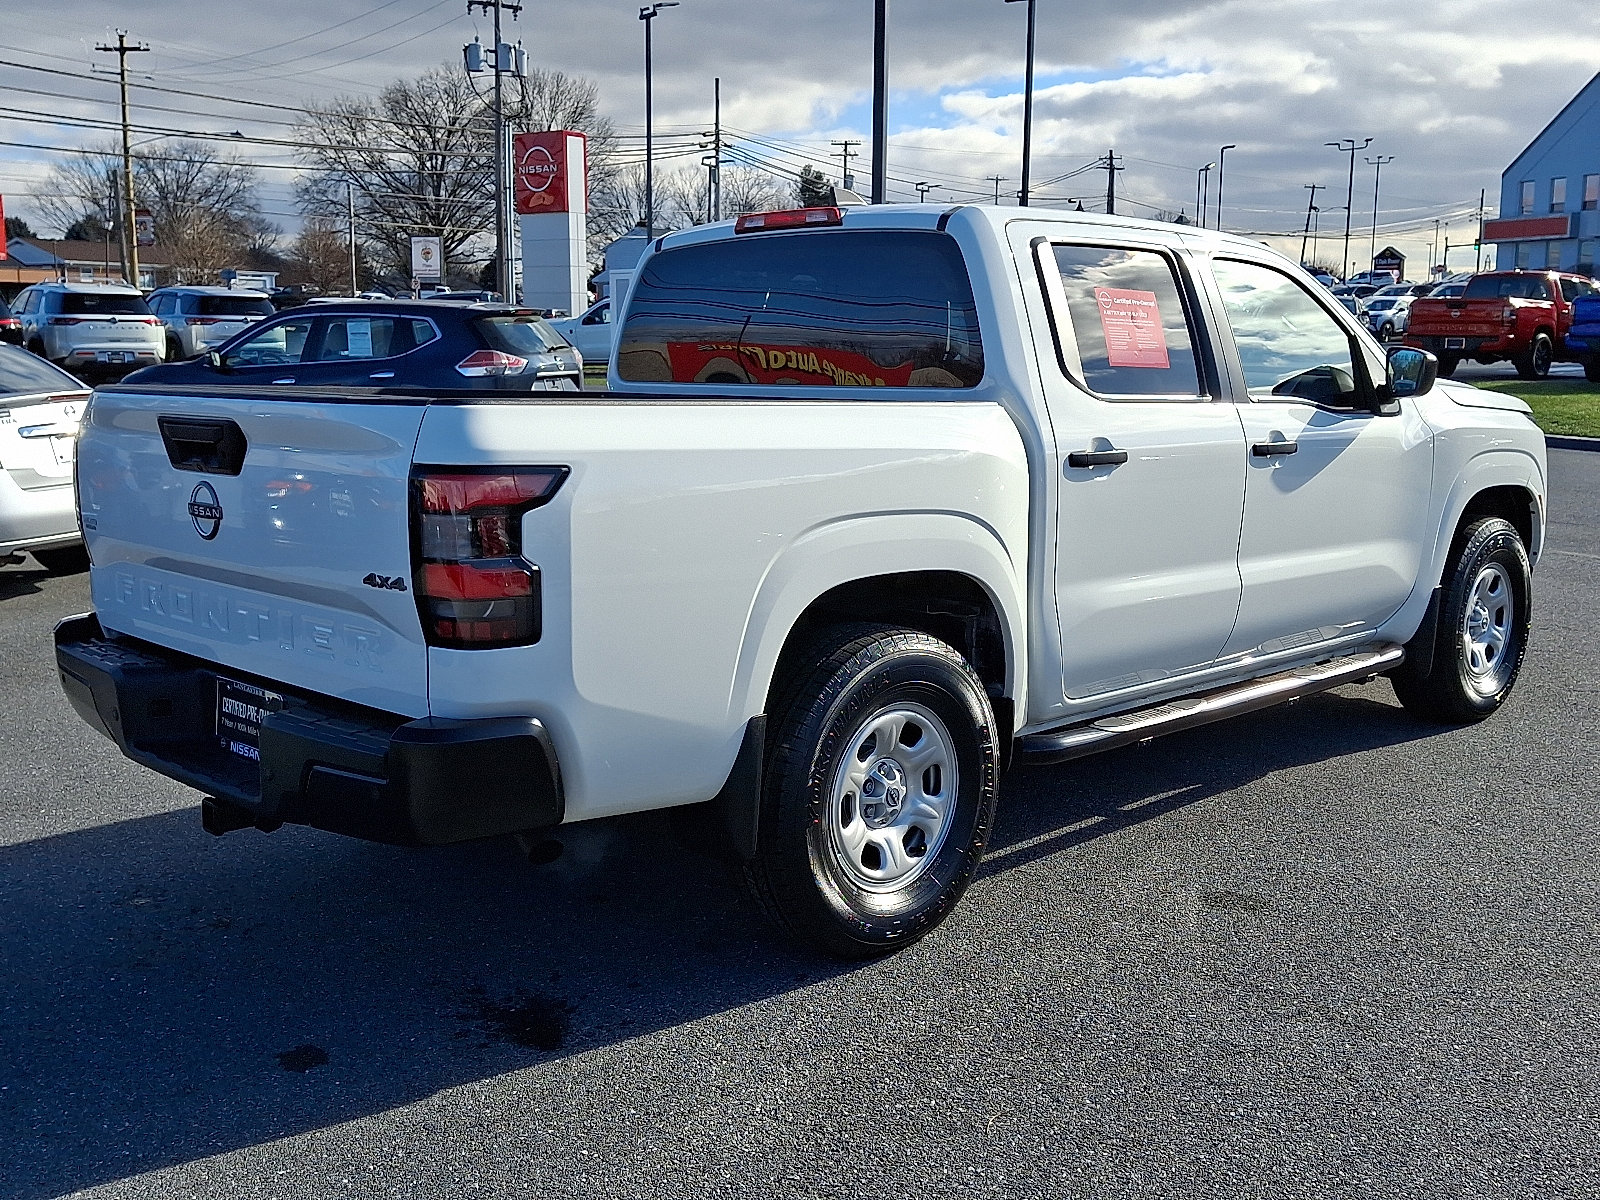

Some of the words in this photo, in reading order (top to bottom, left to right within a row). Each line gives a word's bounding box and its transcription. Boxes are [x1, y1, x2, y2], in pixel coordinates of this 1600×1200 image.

[518, 164, 558, 175] NISSAN
[188, 503, 221, 519] NISSAN
[114, 570, 384, 673] FRONTIER
[222, 697, 247, 718] CERTIFIED
[230, 741, 260, 761] NISSAN
